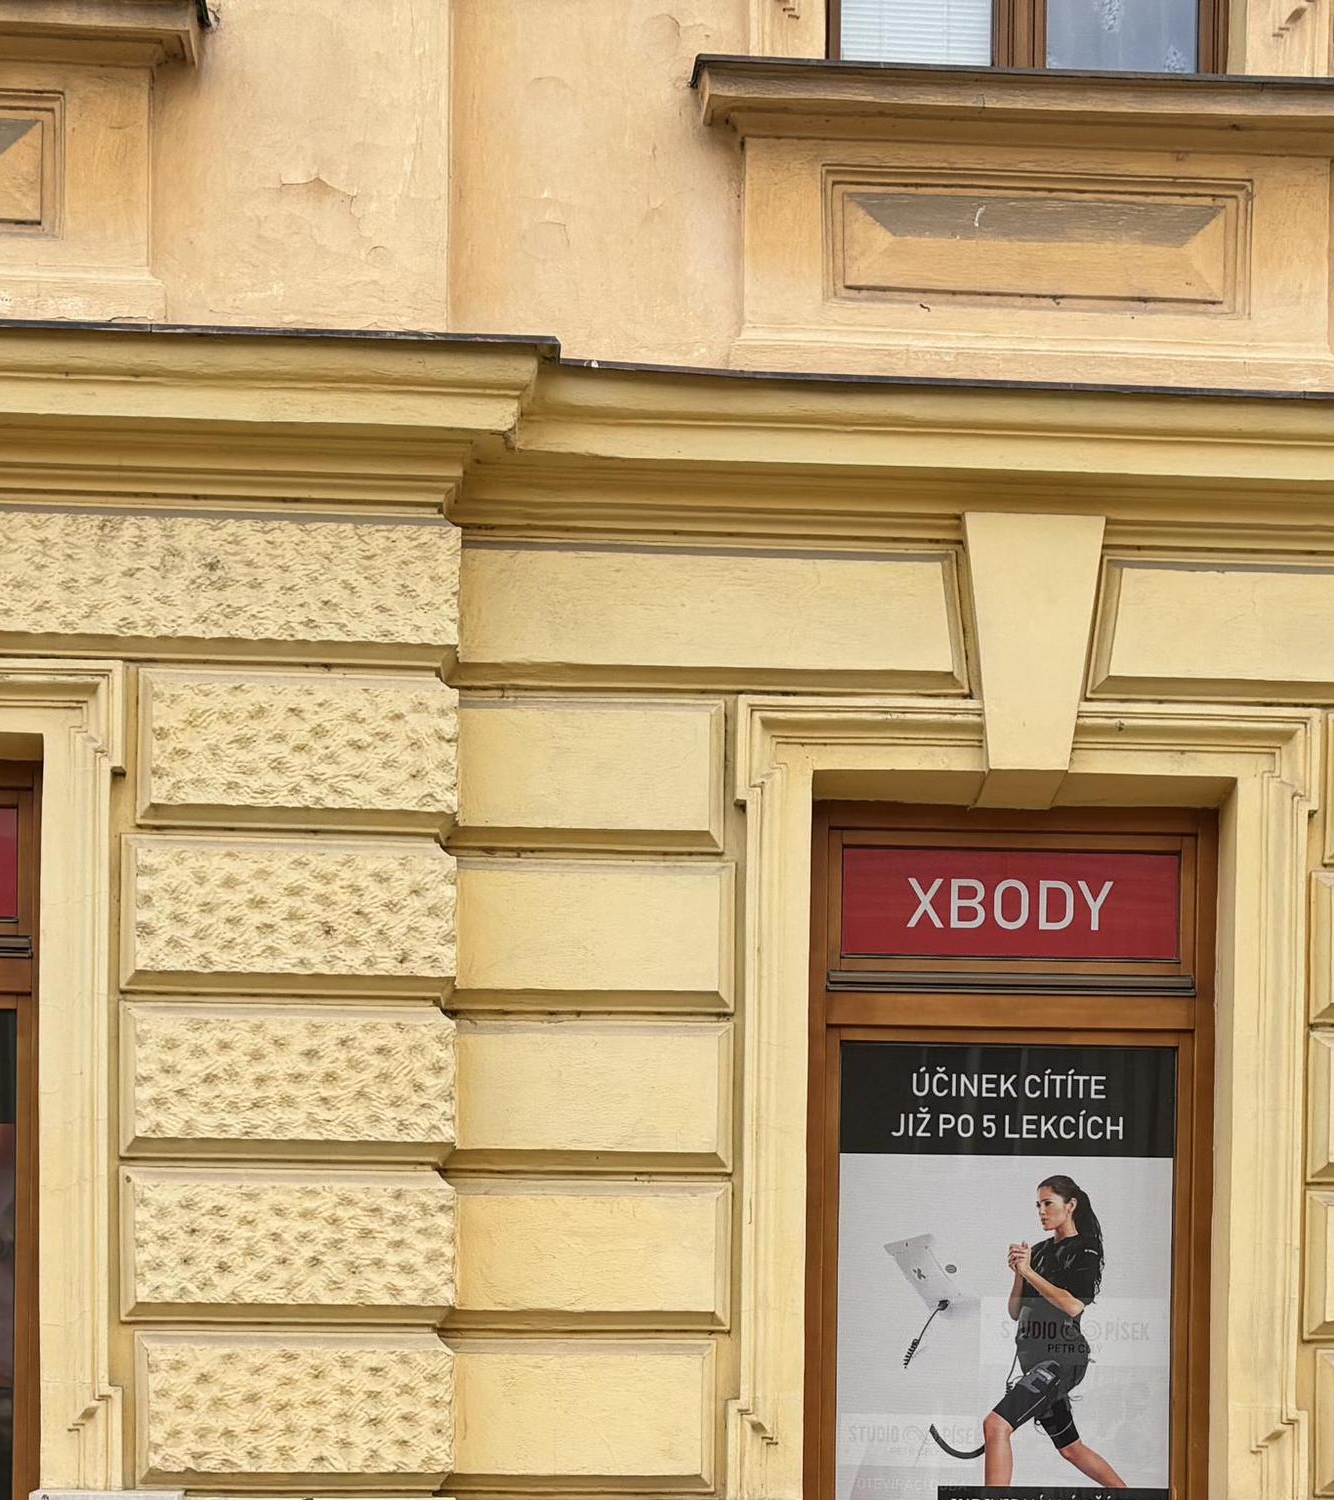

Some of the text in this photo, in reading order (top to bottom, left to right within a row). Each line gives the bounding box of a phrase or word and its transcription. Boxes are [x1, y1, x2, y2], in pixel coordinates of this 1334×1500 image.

[906, 877, 1114, 931] XBODY
[912, 1066, 1107, 1099] ÚČINEK CÍTÍTE
[890, 1106, 1124, 1140] JIŽ PO 5 LEKCÍCH
